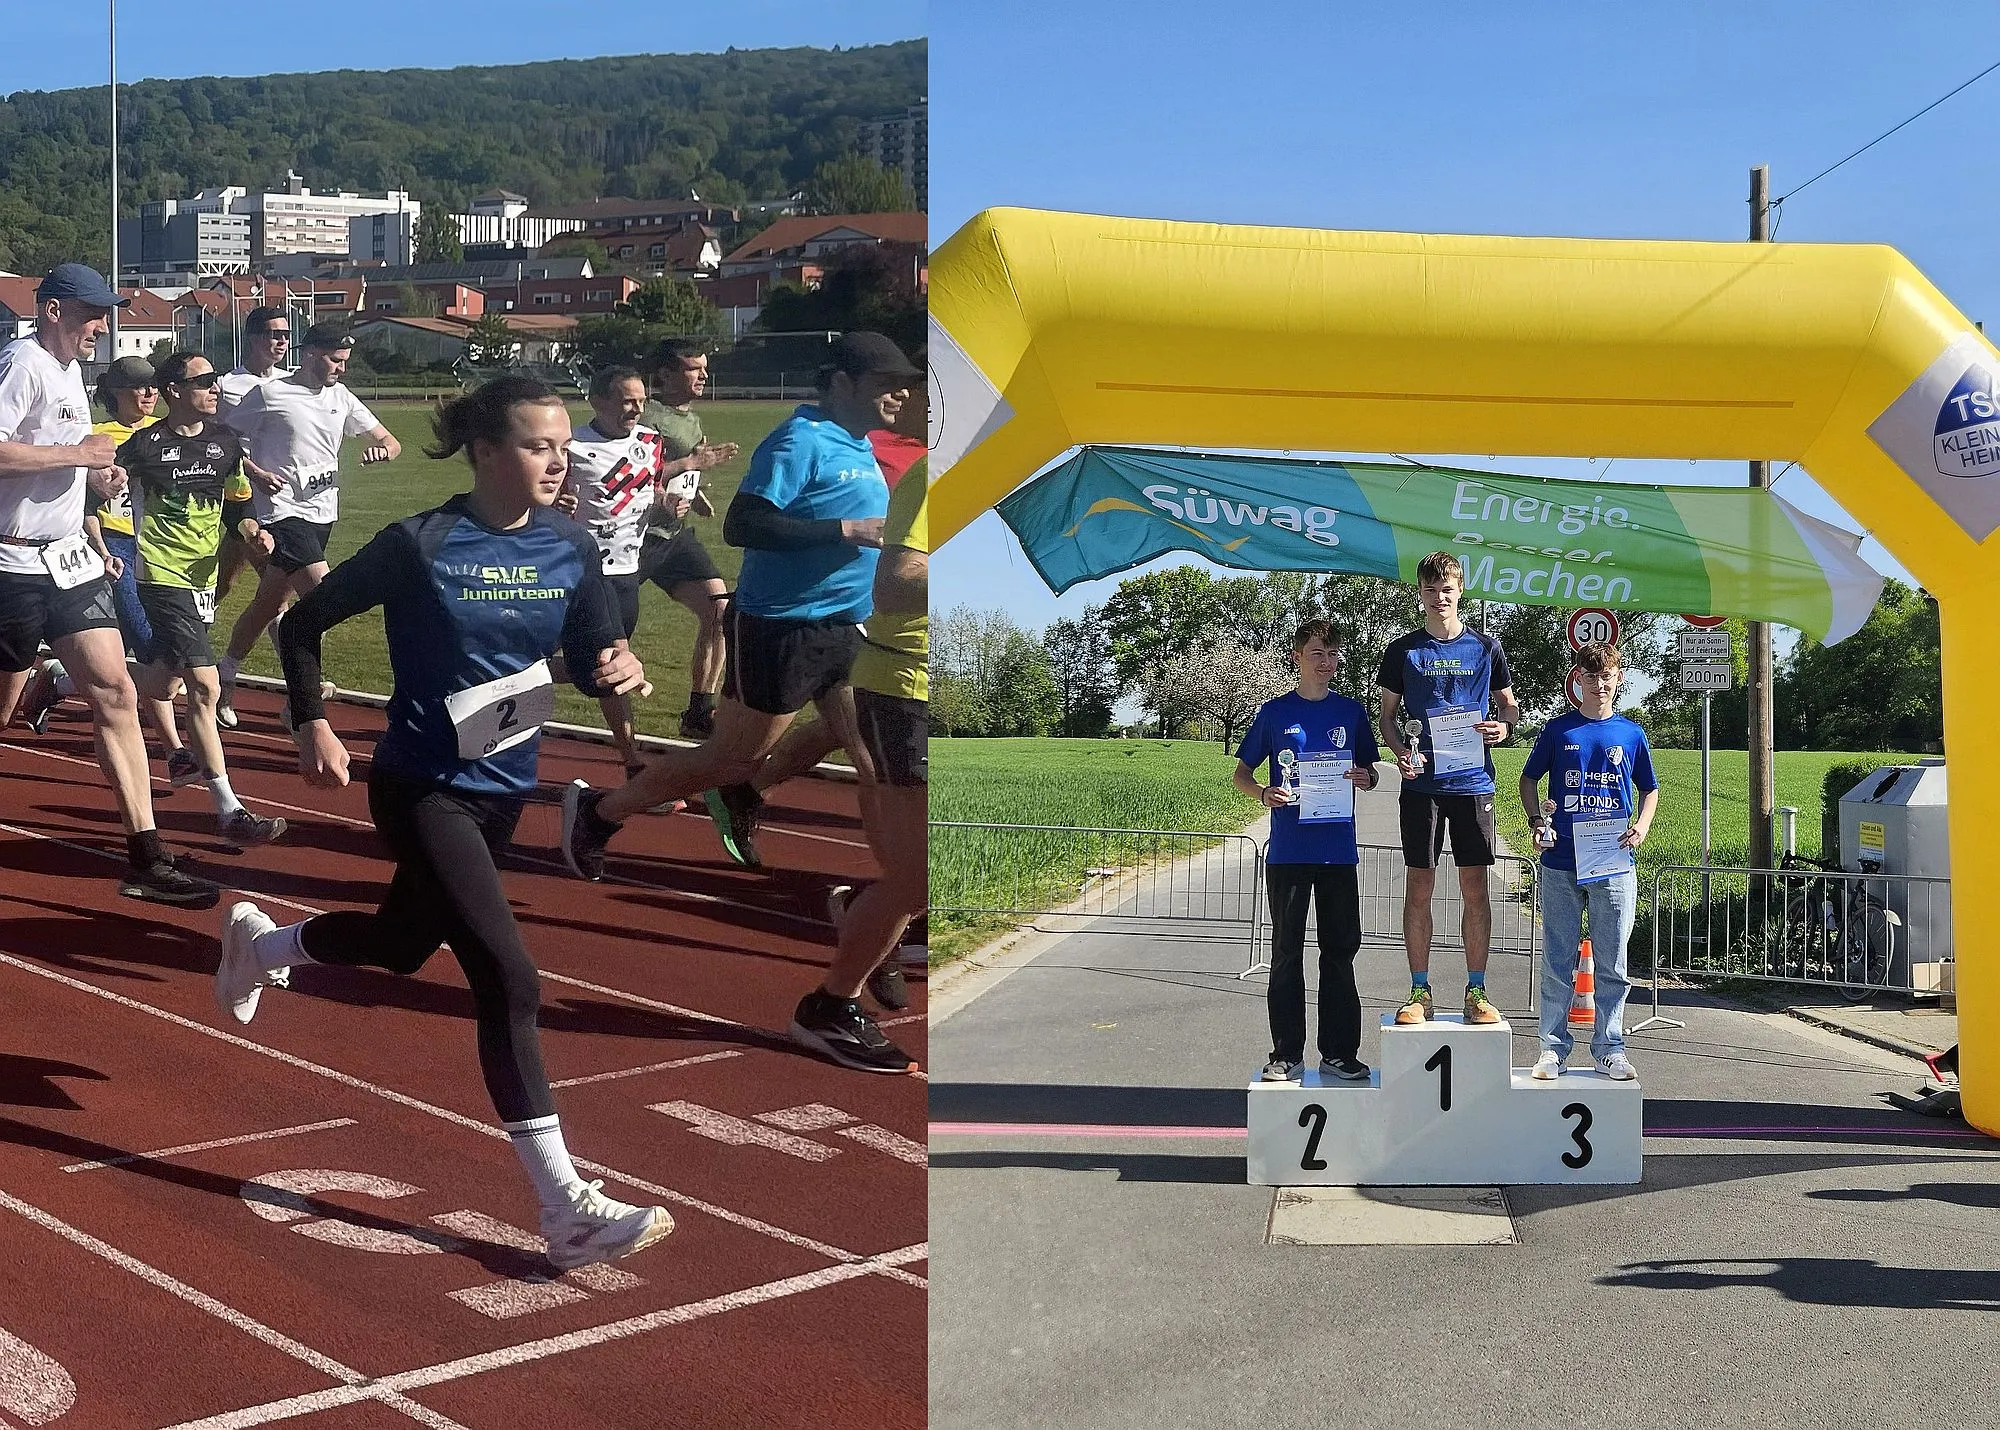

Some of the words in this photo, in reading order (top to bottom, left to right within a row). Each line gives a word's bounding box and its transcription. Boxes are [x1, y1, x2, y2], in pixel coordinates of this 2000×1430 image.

[1142, 484, 1340, 546] Süwag
[1451, 481, 1640, 535] Energie.
[60, 545, 92, 573] 441
[481, 566, 538, 585] SVG
[1457, 553, 1640, 603] Machen.
[457, 587, 565, 600] Juniorteam
[1578, 619, 1608, 643] 30
[1685, 637, 1697, 645] Nur
[1706, 637, 1725, 645] Sonn-
[1683, 646, 1695, 654] und
[1696, 646, 1728, 656] Feiertagen
[496, 699, 518, 731] 2
[1284, 727, 1301, 735] JAKO
[1584, 771, 1622, 785] Heger
[1579, 794, 1620, 809] FONDS
[1424, 1045, 1452, 1112] 1
[1298, 1103, 1328, 1171] 2
[1561, 1102, 1593, 1170] 3
